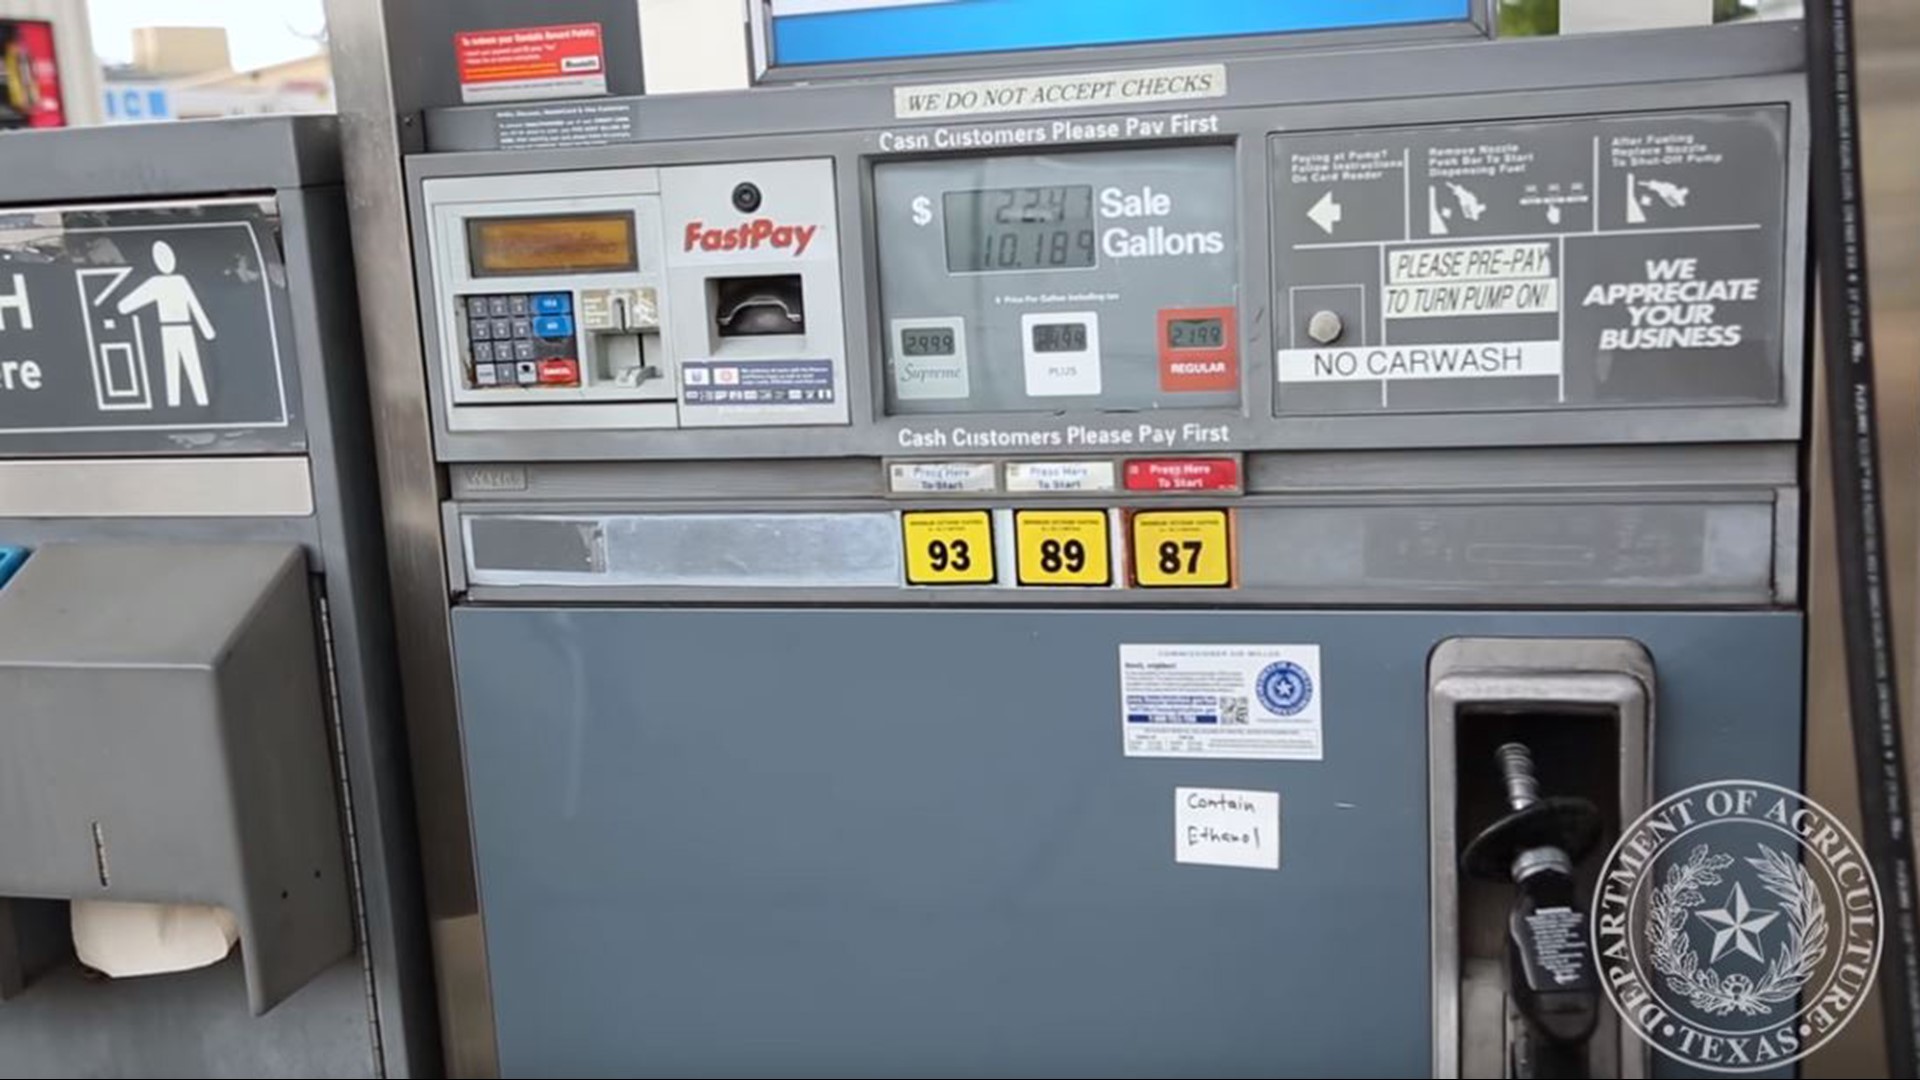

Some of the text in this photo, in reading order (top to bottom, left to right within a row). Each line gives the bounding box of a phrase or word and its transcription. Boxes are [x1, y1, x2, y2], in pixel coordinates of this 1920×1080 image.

[908, 74, 1212, 112] WE DO NOT ACCEPT CHECKS
[934, 126, 1047, 148] Customers
[1052, 120, 1119, 140] Please
[1170, 113, 1219, 134] First
[911, 194, 933, 227] $
[1100, 186, 1171, 217] Sale
[684, 218, 817, 257] FastPay
[1102, 226, 1224, 258] Gallons
[1396, 247, 1549, 279] PLEASE PRE-PAY
[1645, 258, 1698, 281] WE
[1387, 283, 1550, 314] TO TURN PUMP ON!
[1582, 278, 1760, 307] APPRECIATE
[1626, 303, 1716, 327] YOUR
[1599, 325, 1742, 350] BUSINESS
[0, 360, 42, 390] re
[901, 362, 962, 384] Supreme
[1170, 361, 1226, 375] REGULAR
[1314, 346, 1522, 377] NO CARWASH
[898, 422, 1230, 447] Cash Customers Please Pay First
[936, 480, 964, 490] Start
[1038, 479, 1082, 490] To Start
[1157, 477, 1204, 488] To Start
[927, 538, 972, 573] 93
[1040, 538, 1086, 574] 89
[1158, 540, 1203, 575] 87
[1187, 792, 1256, 813] Contain
[1188, 825, 1261, 849] Ethanol
